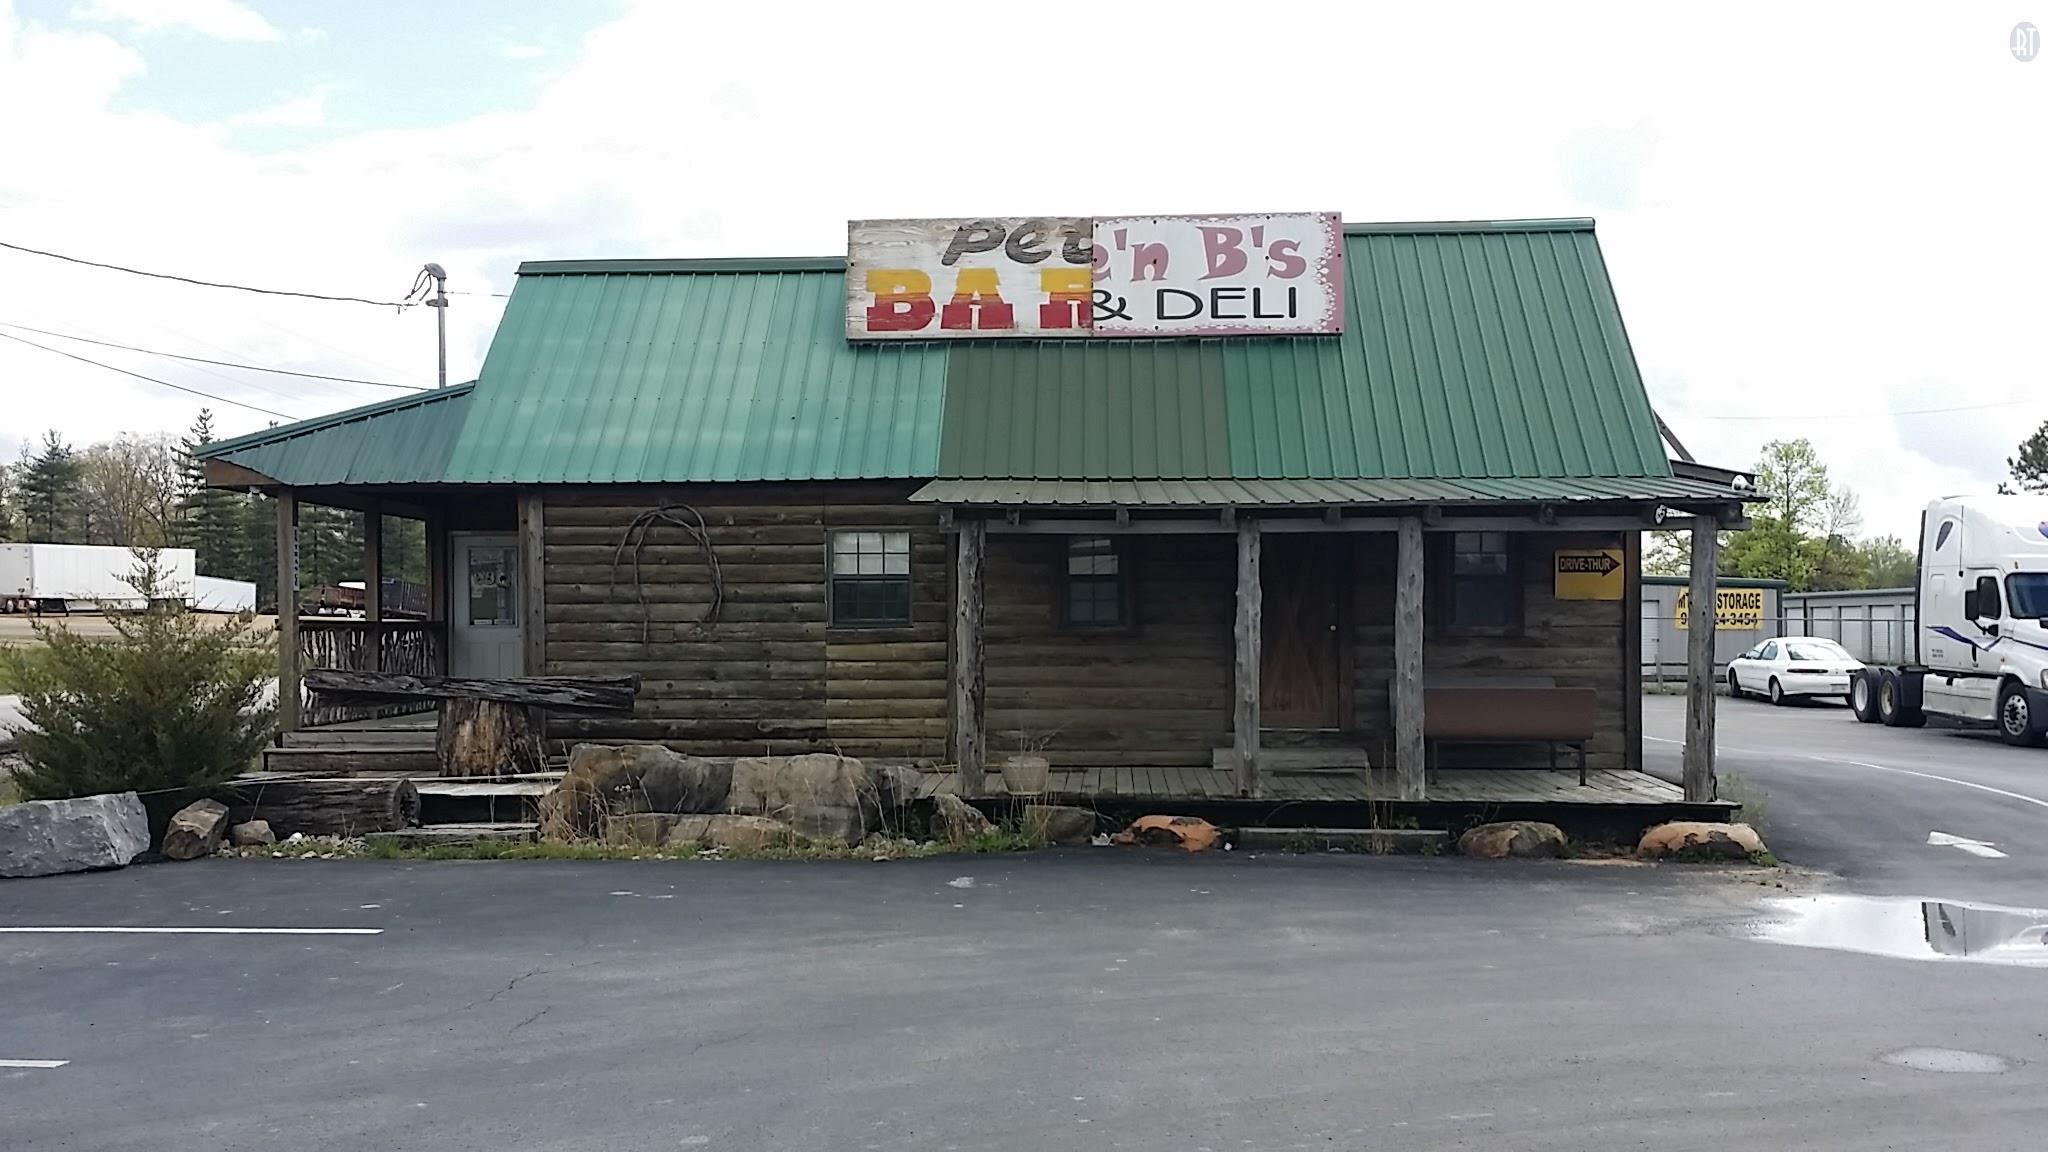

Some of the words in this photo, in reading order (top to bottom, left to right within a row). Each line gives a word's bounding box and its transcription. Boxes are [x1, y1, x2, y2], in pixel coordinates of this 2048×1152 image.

[1196, 225, 1306, 281] B's
[1091, 288, 1134, 321] &
[1156, 286, 1297, 320] DELI
[1716, 592, 1761, 609] STORAGE
